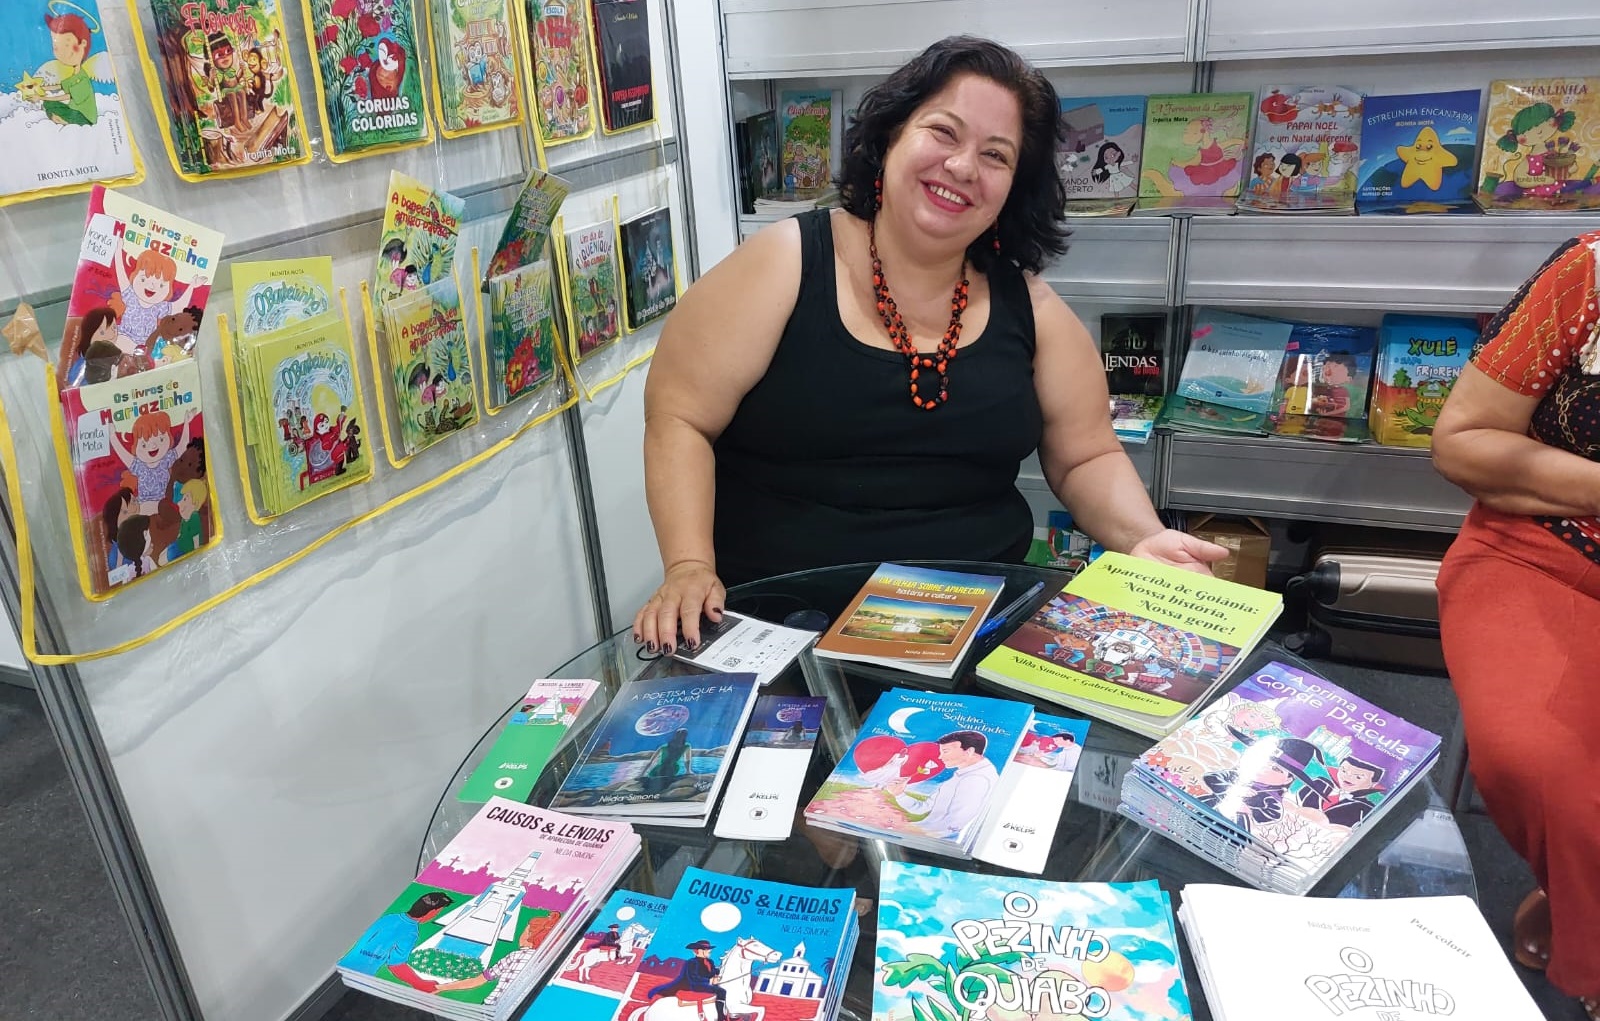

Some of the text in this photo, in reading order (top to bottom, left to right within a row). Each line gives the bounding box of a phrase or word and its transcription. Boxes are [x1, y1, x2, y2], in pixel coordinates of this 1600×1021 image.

[180, 3, 258, 36] Floresta
[356, 97, 410, 114] CORUJAS
[351, 113, 418, 132] COLORIDAS
[1286, 121, 1339, 131] PAPAI NOEL
[1367, 109, 1418, 126] ESTRELINHA
[1291, 134, 1314, 143] Natal
[1315, 134, 1353, 144] diferente
[244, 145, 297, 161] Ironita Mota
[37, 165, 100, 182] IRONITA MOTA
[392, 191, 399, 204] A
[441, 213, 457, 228] seu
[87, 227, 113, 247] Ironita
[130, 212, 198, 248] Os livros de
[86, 239, 109, 257] Mota
[113, 220, 209, 270] Mariazinha
[402, 326, 409, 339] A
[1103, 353, 1158, 371] LENDAS
[112, 379, 179, 404] Os livros de
[99, 388, 193, 425] Mariazinha
[80, 426, 105, 441] Ironita
[82, 439, 104, 451] Mota
[879, 577, 986, 596] UM OLHAR SOBRE APARECIDA
[930, 592, 957, 600] cultura
[1098, 562, 1260, 616] Aparecida de Goiânia:
[1121, 579, 1228, 621] Nossa história,
[1137, 599, 1236, 636] Nossa gente!
[1011, 654, 1038, 672] Nilda
[1039, 663, 1072, 680] Simone
[1080, 677, 1118, 695] Gabriel
[1118, 688, 1161, 707] Siqueira
[643, 689, 687, 701] POETISA
[690, 686, 717, 695] QUE
[657, 695, 701, 706] EM MIM
[1290, 675, 1387, 728] A prima do
[1255, 673, 1412, 756] Conde Drácula
[627, 791, 661, 802] Simone
[486, 805, 615, 844] CAUSOS & LENDAS
[547, 835, 575, 846] APARECIDA
[554, 847, 596, 860] NILDA SIMONE
[623, 897, 647, 909] CAUSOS
[647, 902, 654, 910] &
[688, 877, 842, 917] CAUSOS & LENDAS
[1002, 890, 1038, 919] O
[766, 909, 801, 922] APARECIDA
[801, 914, 809, 922] DE
[781, 924, 832, 937] NILDA SIMONE
[1409, 917, 1473, 960] Para colorir
[951, 918, 1111, 963] PEZINHO
[1020, 956, 1049, 972] DE
[1339, 945, 1374, 974] O
[952, 970, 1112, 1021] QUIABO
[1304, 973, 1456, 1017] PEZINHO
